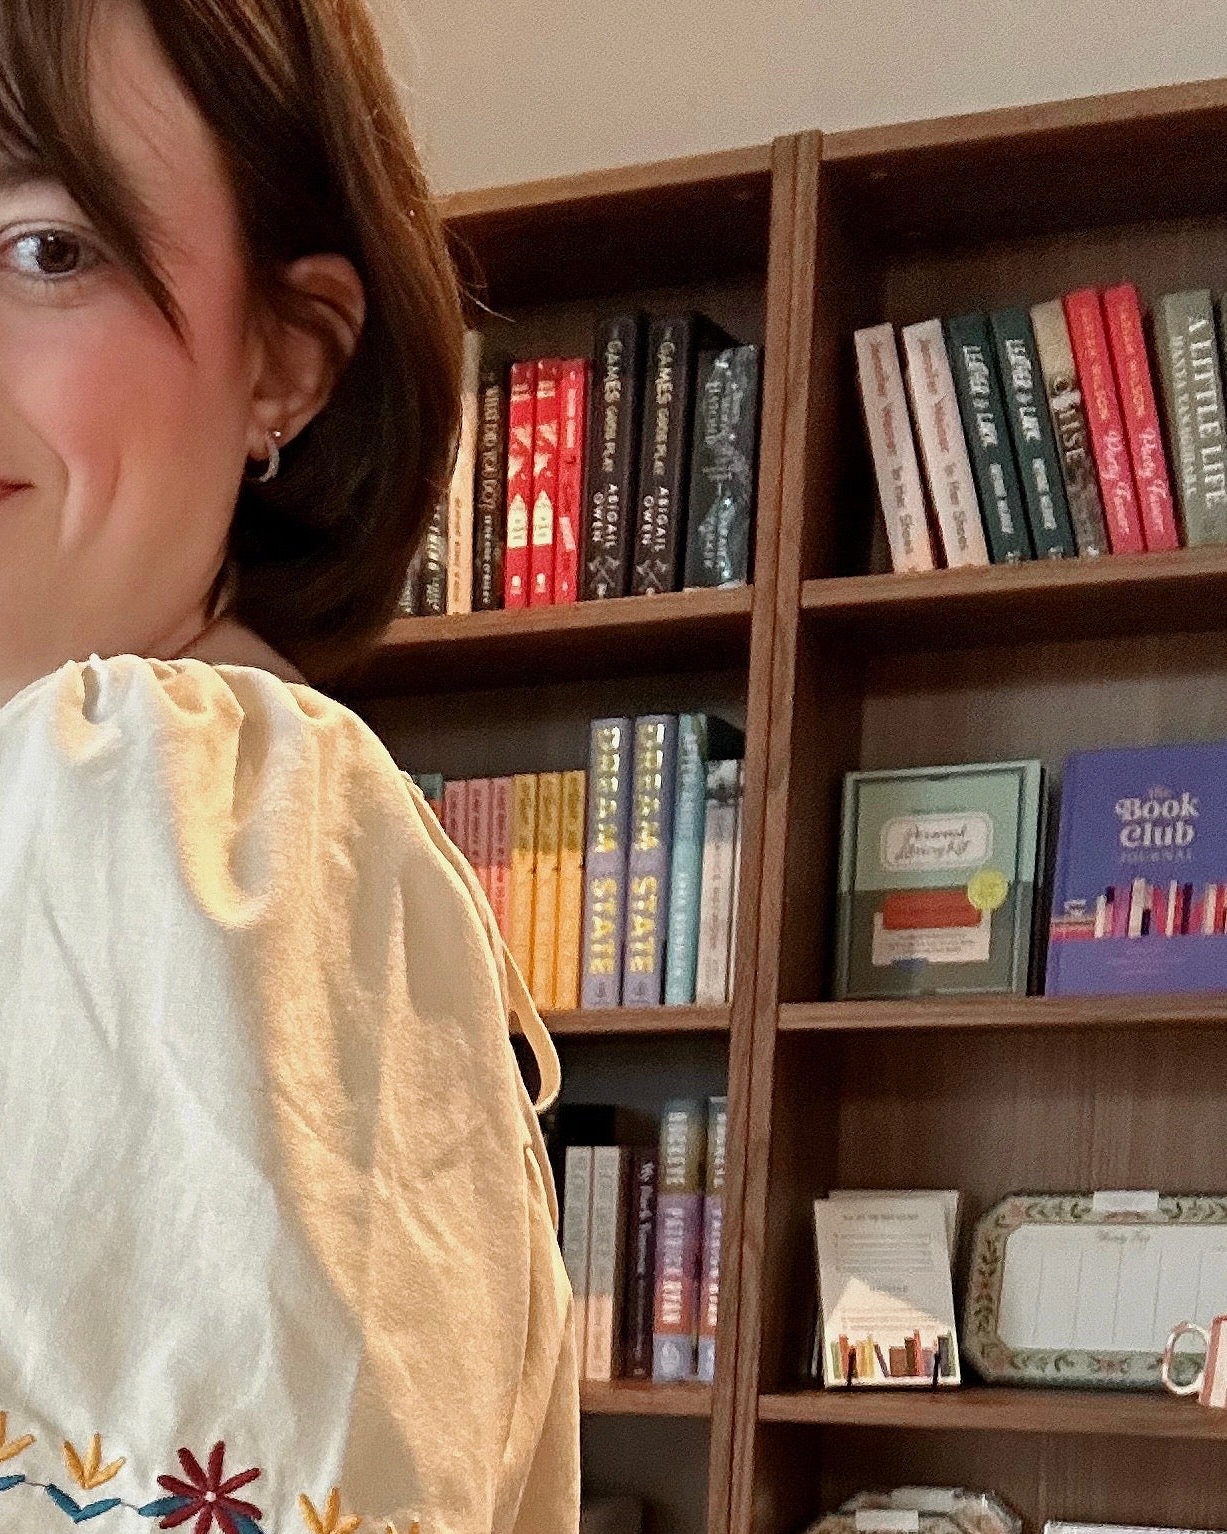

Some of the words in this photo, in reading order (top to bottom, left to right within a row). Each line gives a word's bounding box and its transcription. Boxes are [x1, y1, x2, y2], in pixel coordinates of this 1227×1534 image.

[1187, 315, 1209, 333] A
[603, 340, 622, 402] GAMES
[655, 341, 674, 402] GAMES
[1189, 341, 1219, 438] LITTLE
[1201, 448, 1225, 508] LIFE
[590, 492, 604, 543] OWEN
[602, 483, 618, 549] ABIGAIL
[640, 495, 654, 545] OWEN
[653, 487, 669, 552] ABIGAIL
[1115, 792, 1200, 822] Book
[1119, 820, 1195, 849] Club
[590, 878, 617, 974] STATE
[631, 876, 657, 973] STATE
